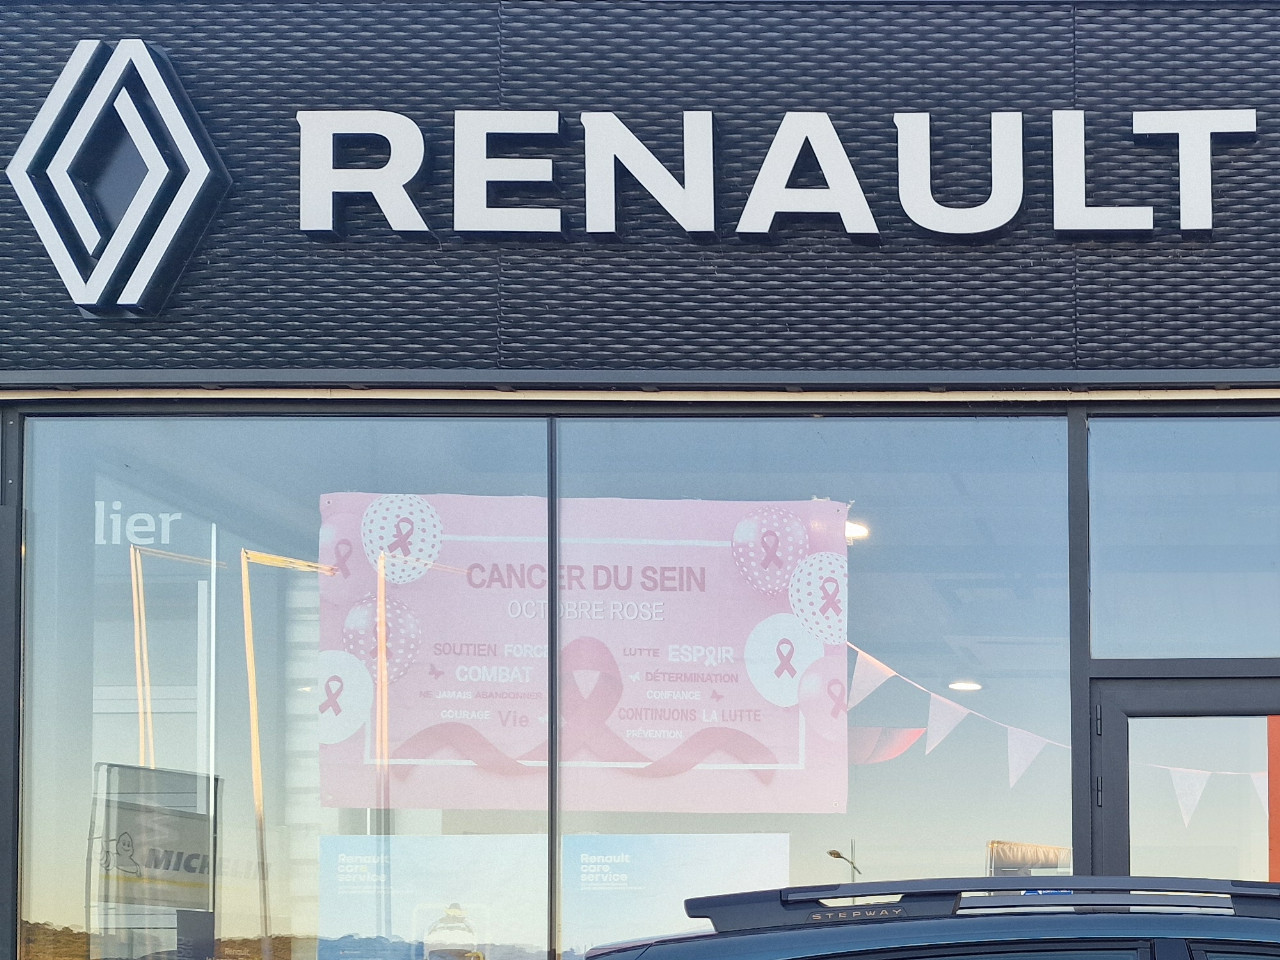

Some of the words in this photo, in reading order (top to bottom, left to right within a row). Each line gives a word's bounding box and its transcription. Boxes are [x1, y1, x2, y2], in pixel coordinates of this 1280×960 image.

[296, 108, 1258, 236] RENAULT
[94, 501, 182, 545] lier
[466, 562, 586, 592] CANCER
[592, 564, 633, 592] DU
[640, 565, 706, 593] SEIN
[507, 600, 604, 621] OCTOBRE
[610, 601, 665, 622] ROSE
[433, 642, 497, 657] SOUTIEN
[623, 647, 660, 658] LUTTE
[455, 664, 534, 683] COMBAT
[645, 668, 739, 683] DÉTERMINATION
[435, 690, 472, 700] JAMAIS
[474, 690, 543, 700] ABANDONNER
[646, 689, 701, 700] CONFIANCE
[440, 709, 491, 720] COURAGE
[498, 710, 530, 727] Vie
[618, 707, 697, 722] CONTINUONS
[702, 709, 718, 722] LA
[721, 708, 761, 722] LUTTE
[626, 727, 684, 739] PRÉVENTION
[580, 852, 631, 863] Renault
[580, 872, 628, 882] service
[812, 908, 902, 920] STEPWAY
